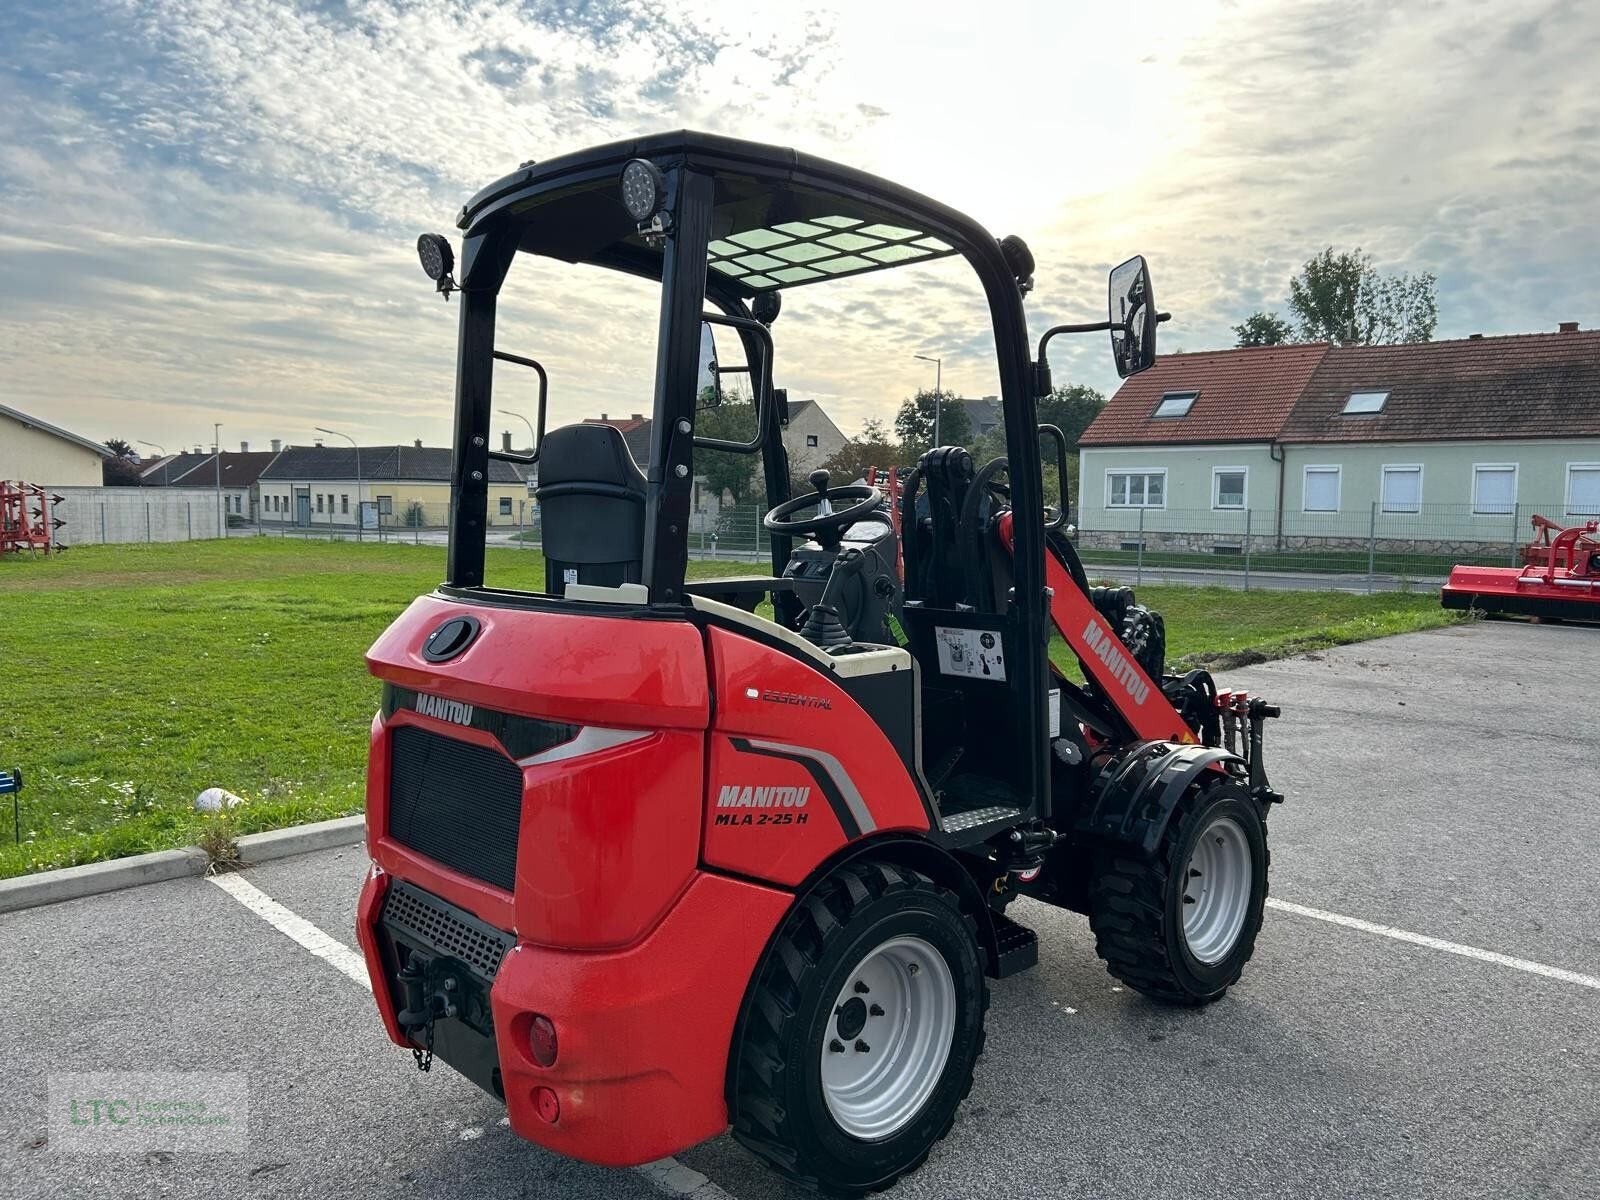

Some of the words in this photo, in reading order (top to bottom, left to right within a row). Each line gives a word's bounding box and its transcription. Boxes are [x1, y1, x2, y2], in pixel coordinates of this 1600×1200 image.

[1082, 619, 1150, 705] MANITOU
[415, 692, 473, 726] MANITOU
[762, 689, 832, 710] ESSENTIAL
[717, 785, 810, 808] MANITOU
[715, 813, 753, 825] MLA
[757, 813, 793, 825] 2-25
[796, 813, 808, 824] H
